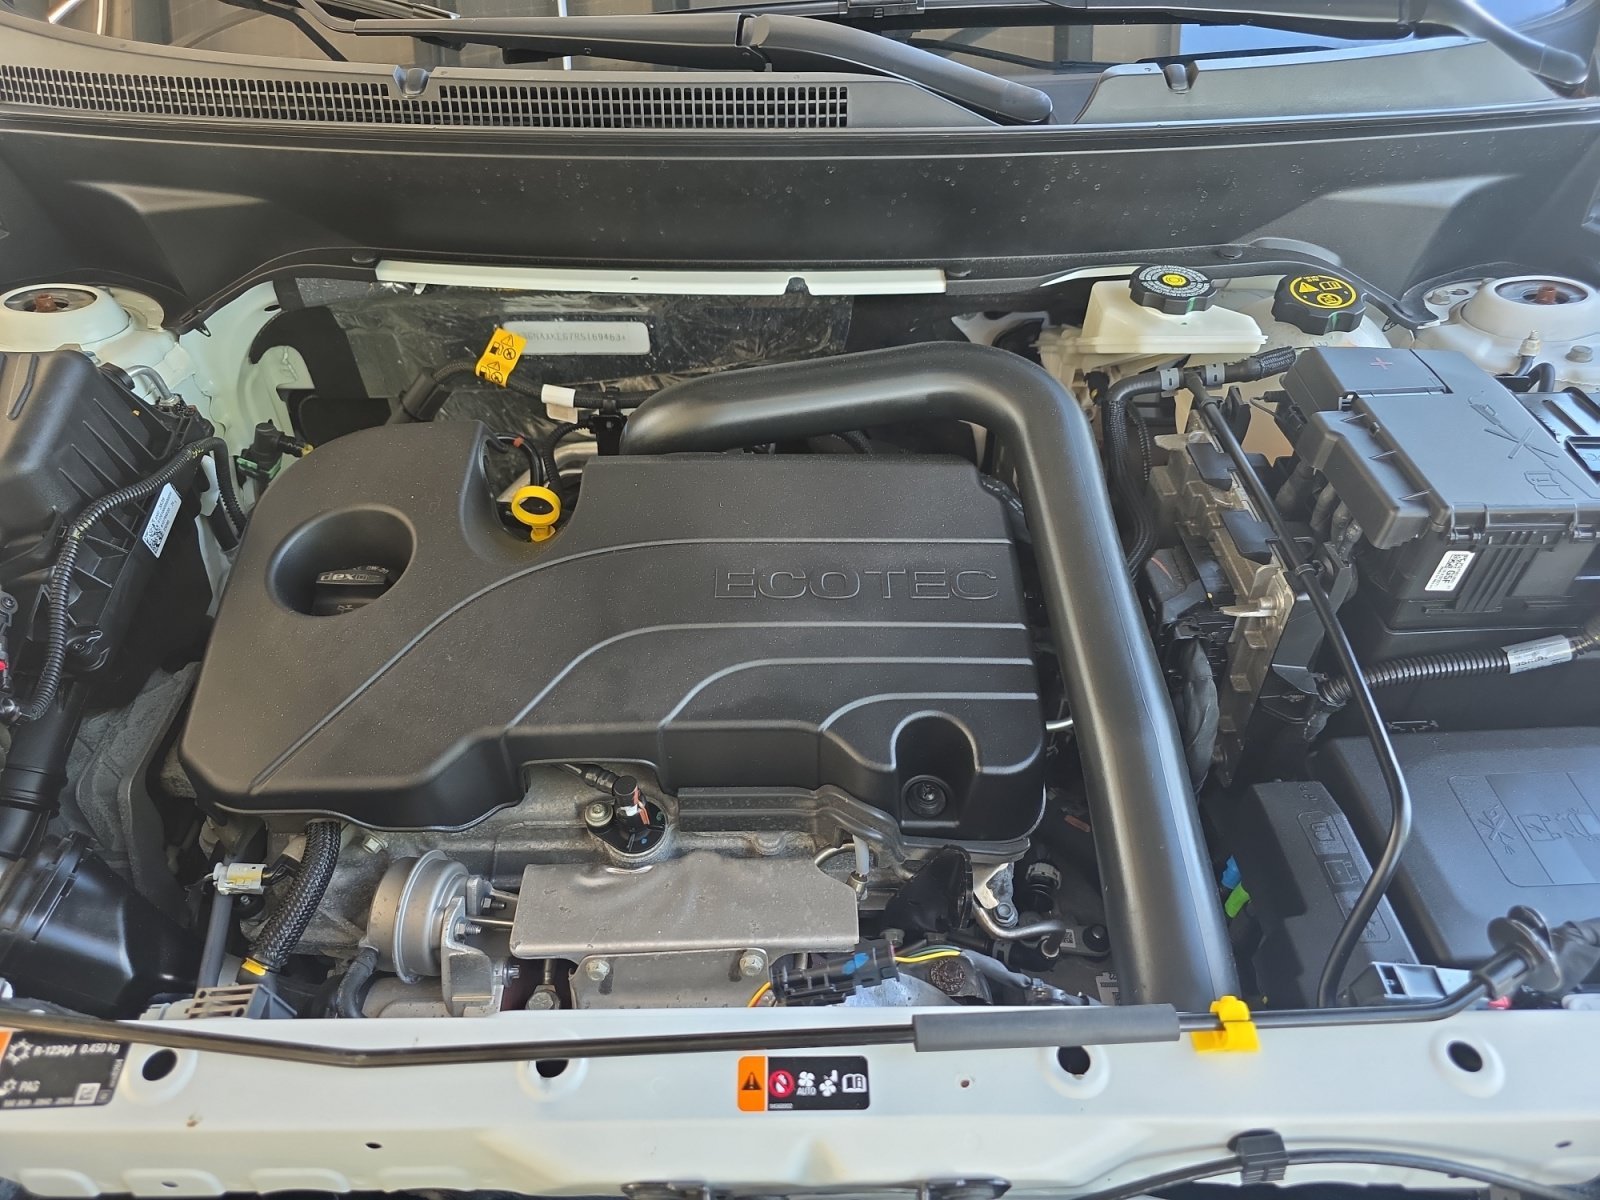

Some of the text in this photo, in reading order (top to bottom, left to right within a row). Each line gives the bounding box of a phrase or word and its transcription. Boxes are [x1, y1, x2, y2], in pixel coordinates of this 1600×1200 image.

[714, 567, 999, 600] ECOTEC
[80, 1043, 106, 1055] 0.450
[107, 1043, 120, 1055] kg
[796, 1086, 817, 1096] AUTO
